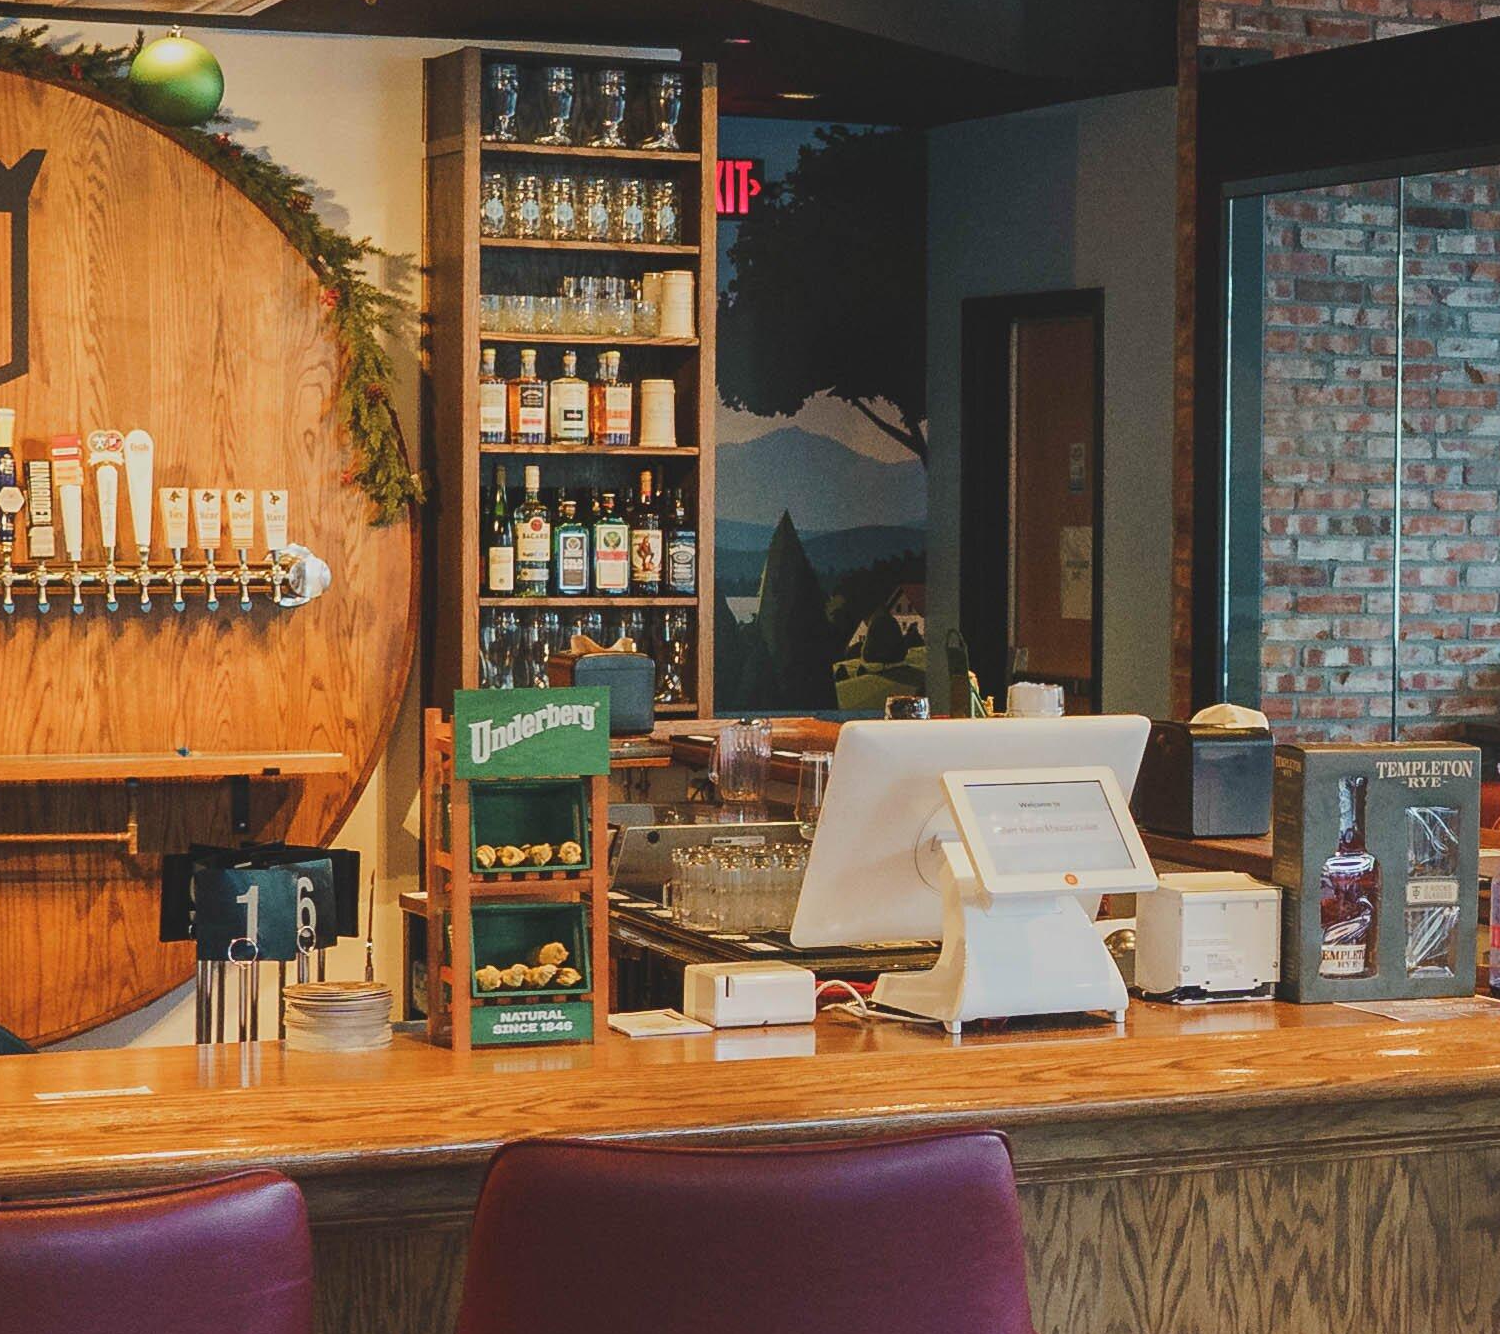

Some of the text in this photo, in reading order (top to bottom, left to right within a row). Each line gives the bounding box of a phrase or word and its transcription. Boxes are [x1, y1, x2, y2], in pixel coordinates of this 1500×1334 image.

[716, 159, 754, 215] XIT
[468, 703, 597, 764] Underberg
[1375, 760, 1474, 779] TEMPLETON
[235, 884, 260, 947] 1
[297, 876, 317, 939] 6
[492, 1021, 573, 1035] SINCE 1846
[499, 1010, 567, 1024] NATURAL
